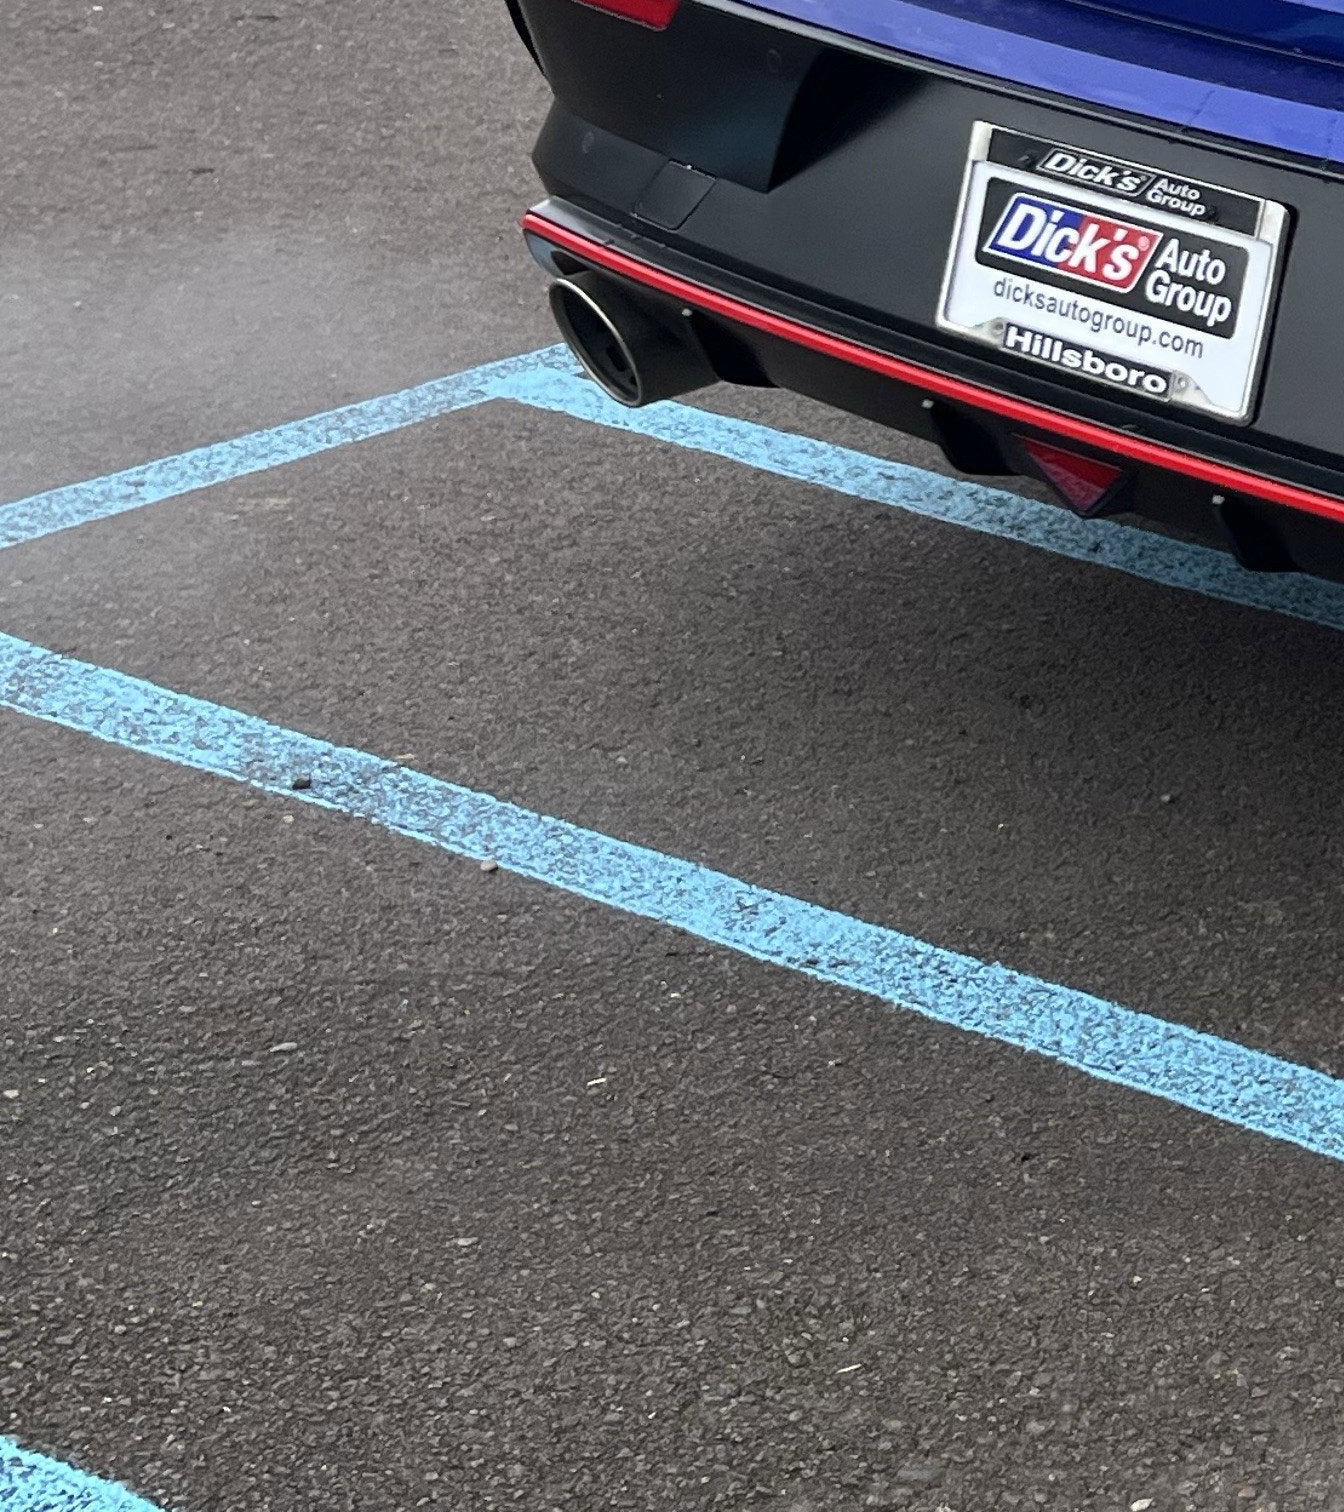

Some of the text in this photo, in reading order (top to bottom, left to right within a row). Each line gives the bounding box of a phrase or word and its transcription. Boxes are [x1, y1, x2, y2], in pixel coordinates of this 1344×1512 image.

[1044, 152, 1142, 192] Dick's
[1152, 178, 1201, 201] Auto
[1146, 189, 1206, 216] Group
[998, 202, 1141, 282] Dick's
[1156, 238, 1227, 285] Auto
[993, 277, 1203, 359] dicksautogroup.com
[1145, 270, 1233, 327] Group
[1005, 324, 1168, 393] Hillsboro
